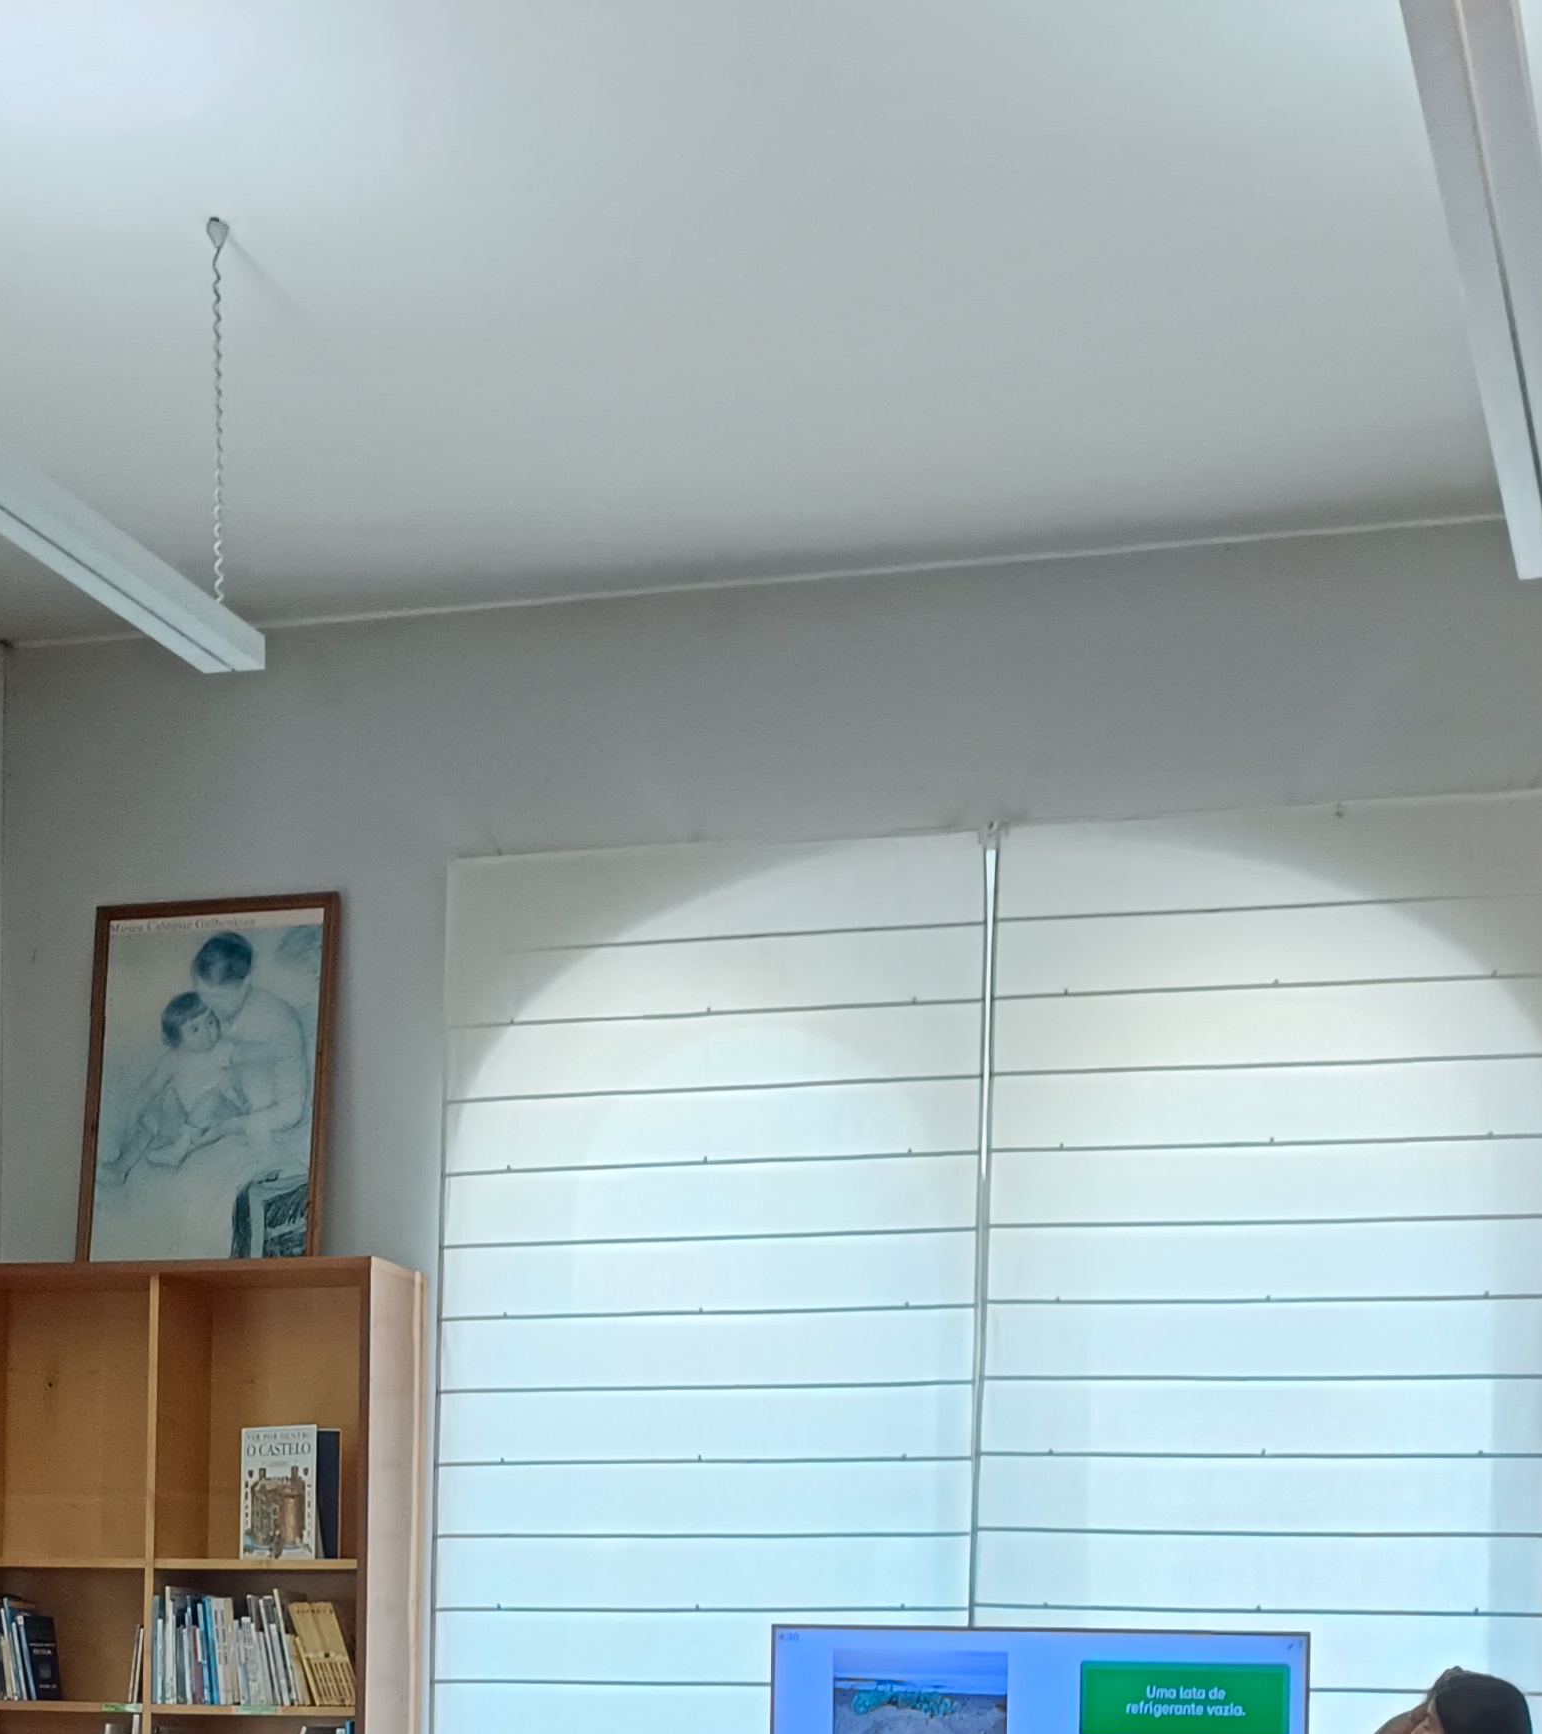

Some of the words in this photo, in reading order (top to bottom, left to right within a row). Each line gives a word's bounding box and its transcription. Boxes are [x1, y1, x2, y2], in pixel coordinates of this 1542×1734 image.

[246, 1444, 256, 1457] O
[259, 1442, 311, 1457] CASTELO
[1146, 1685, 1177, 1700] Uma
[1179, 1685, 1206, 1700] lata
[1208, 1687, 1226, 1701] de
[1125, 1700, 1204, 1718] refrigerante
